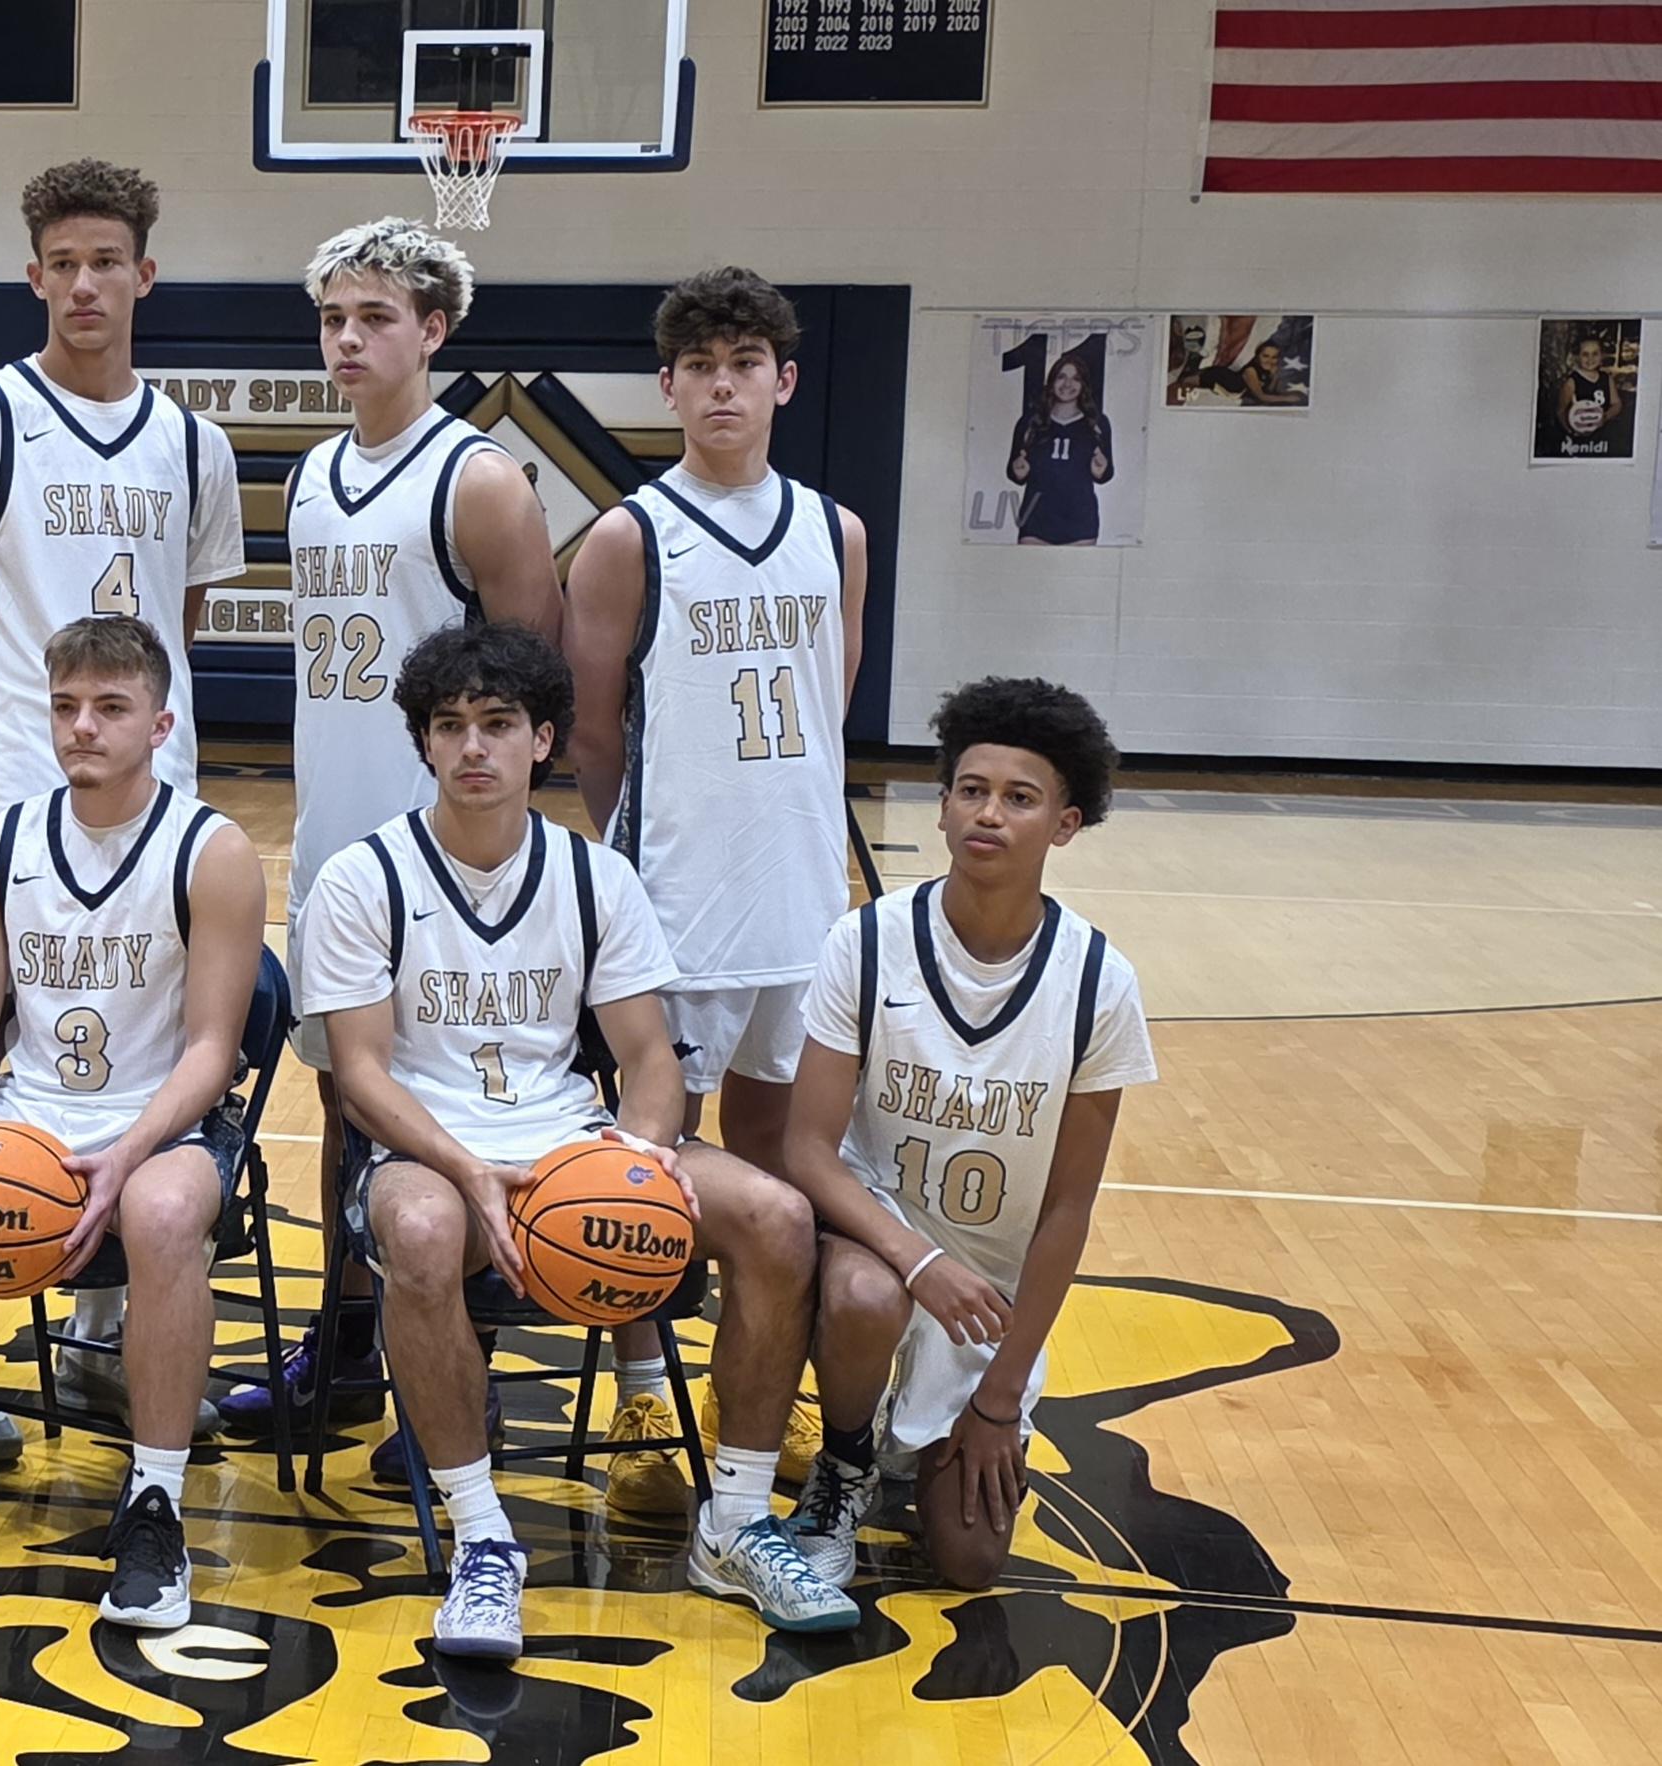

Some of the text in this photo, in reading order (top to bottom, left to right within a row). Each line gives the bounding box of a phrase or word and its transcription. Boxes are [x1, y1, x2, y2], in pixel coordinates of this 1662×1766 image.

[775, 16, 980, 32] 2003 2004 2018 2019 2020
[777, 0, 980, 14] 1992 1993 1994 2001 2002
[774, 35, 893, 51] 2021 2022 2023
[1051, 437, 1070, 460] 11
[44, 484, 172, 541] SHADY
[968, 490, 1042, 530] LIV
[92, 553, 140, 616] 4
[296, 544, 397, 598] SHADY
[689, 595, 827, 655] SHADY
[303, 613, 388, 702] 22
[731, 666, 806, 761] 11
[18, 932, 152, 990] SHADY
[418, 968, 562, 1026] SHADY
[55, 1007, 114, 1092] 3
[470, 1042, 518, 1105] 1
[877, 1059, 1048, 1137] SHADY
[894, 1135, 1007, 1226] 10
[582, 1215, 686, 1260] Wilson
[575, 1279, 664, 1309] NCAA
